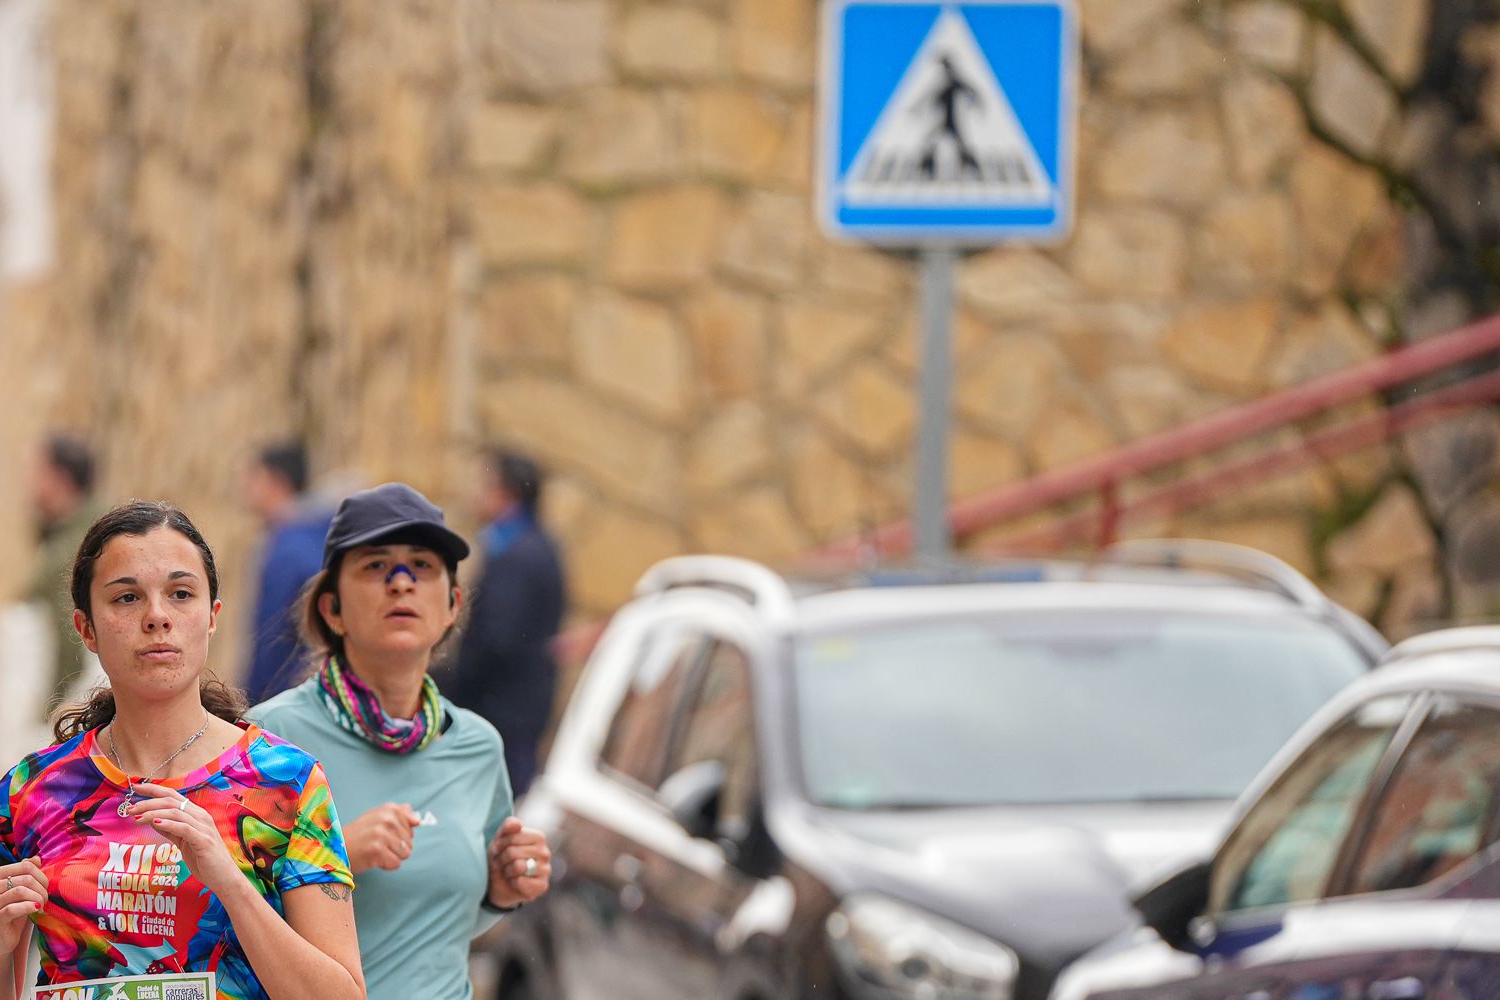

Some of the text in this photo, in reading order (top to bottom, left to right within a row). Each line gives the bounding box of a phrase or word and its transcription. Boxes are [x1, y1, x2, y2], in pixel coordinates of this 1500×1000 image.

[100, 841, 156, 874] XII
[154, 865, 180, 875] MARZO
[97, 871, 150, 893] MEDIA
[151, 875, 179, 887] 2026
[96, 890, 177, 916] MARATÓN
[98, 912, 140, 934] & 10K
[141, 915, 175, 927] Ciudad de
[141, 924, 175, 937] LUCENA
[165, 987, 198, 995] carreras
